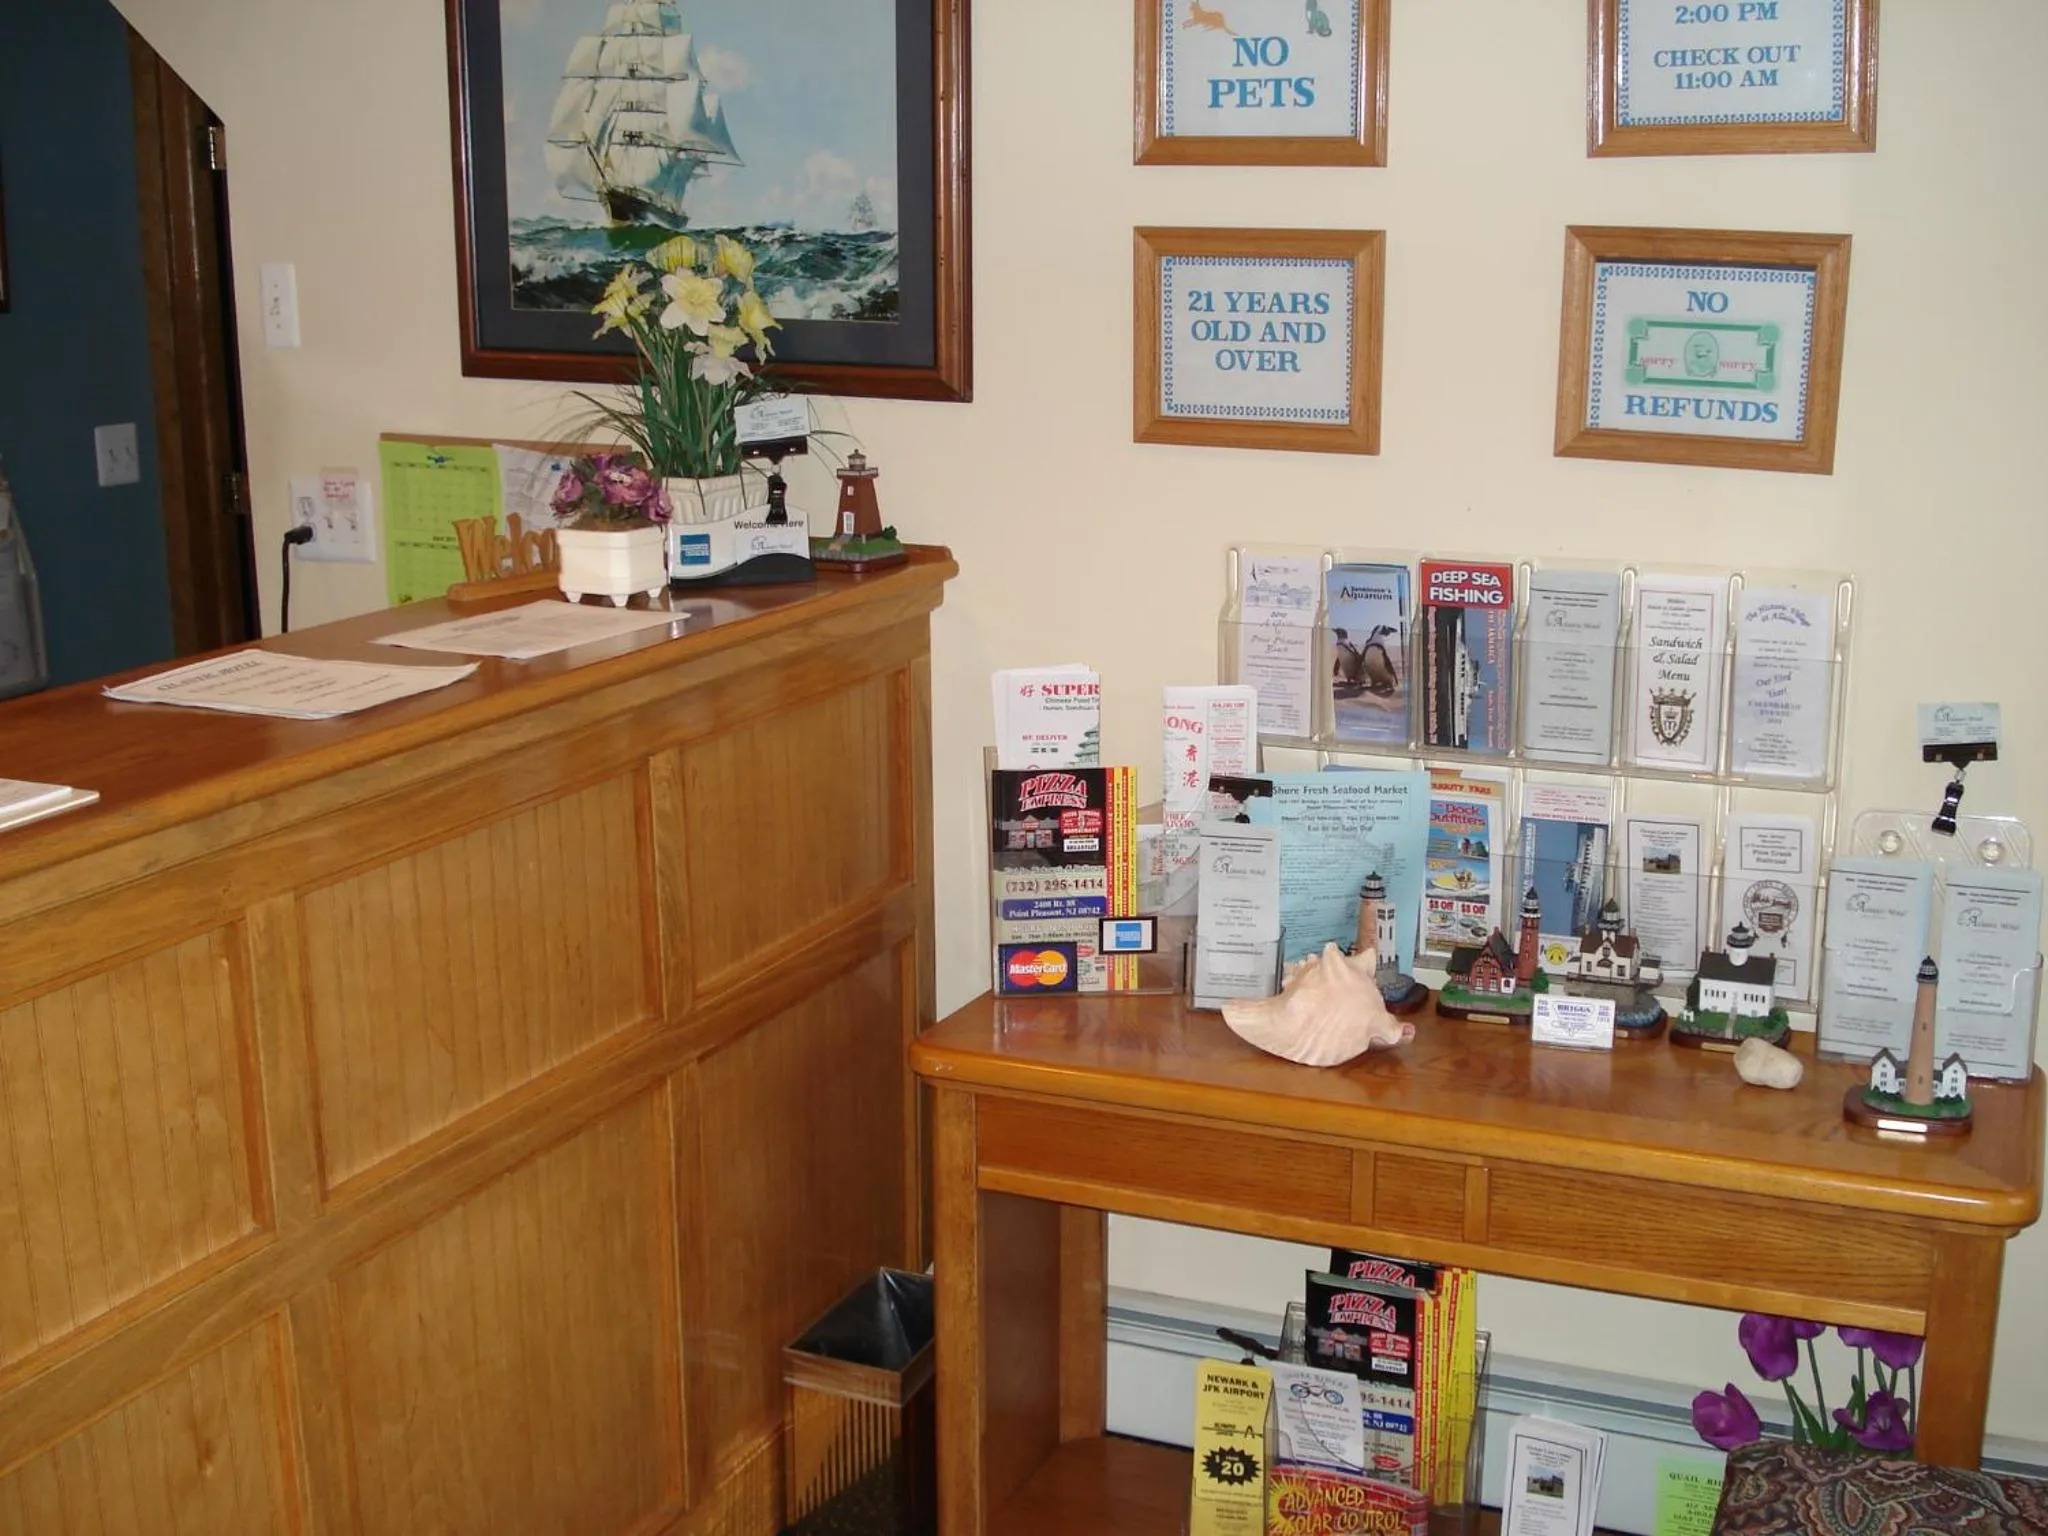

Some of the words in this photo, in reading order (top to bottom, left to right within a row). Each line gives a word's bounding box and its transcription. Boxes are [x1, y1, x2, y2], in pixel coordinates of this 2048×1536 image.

[1675, 4, 1729, 24] 2:00
[1737, 2, 1778, 22] PM
[1232, 36, 1290, 67] NO
[1653, 48, 1740, 68] CHECK
[1747, 44, 1801, 64] OUT
[1675, 71, 1732, 90] 11:00
[1740, 69, 1778, 87] AM
[1207, 77, 1315, 108] PETS
[1187, 290, 1215, 312] 21
[1224, 291, 1330, 315] YEARS
[1686, 291, 1729, 313] NO
[1191, 319, 1251, 342] OLD
[1258, 321, 1327, 344] AND
[1215, 349, 1301, 372] OVER
[1624, 394, 1779, 424] REFUNDS
[1431, 571, 1468, 584] DEEP
[1471, 574, 1501, 587] SEA
[1340, 587, 1393, 600] Aquarium
[1429, 587, 1504, 604] FISHING
[1649, 635, 1703, 649] Sandwich
[1652, 653, 1664, 663] &
[1668, 653, 1699, 665] Salad
[1658, 669, 1690, 681] Menu
[1041, 683, 1099, 696] SUPER
[1020, 772, 1087, 801] PIZZA
[1273, 784, 1299, 795] Shore
[1303, 786, 1329, 795] Fresh
[1333, 785, 1371, 795] Seafood
[1374, 785, 1408, 795] Market
[1006, 879, 1040, 892] (732)
[1045, 878, 1103, 890] 295-1414
[1009, 910, 1029, 918] Point
[1031, 909, 1064, 918] Pleasant,
[1009, 963, 1067, 974] MasterCard
[1347, 1260, 1415, 1288] PIZZA
[1329, 1292, 1396, 1320] PIZZA
[1330, 1311, 1396, 1332] EXPRESS
[1207, 1374, 1248, 1387] NEWARK
[1203, 1385, 1220, 1394] JFK
[1223, 1388, 1264, 1399] AIRPORT
[1220, 1462, 1244, 1476] 20
[1669, 1472, 1700, 1483] QUAIL
[1284, 1487, 1364, 1512] ADVANCED
